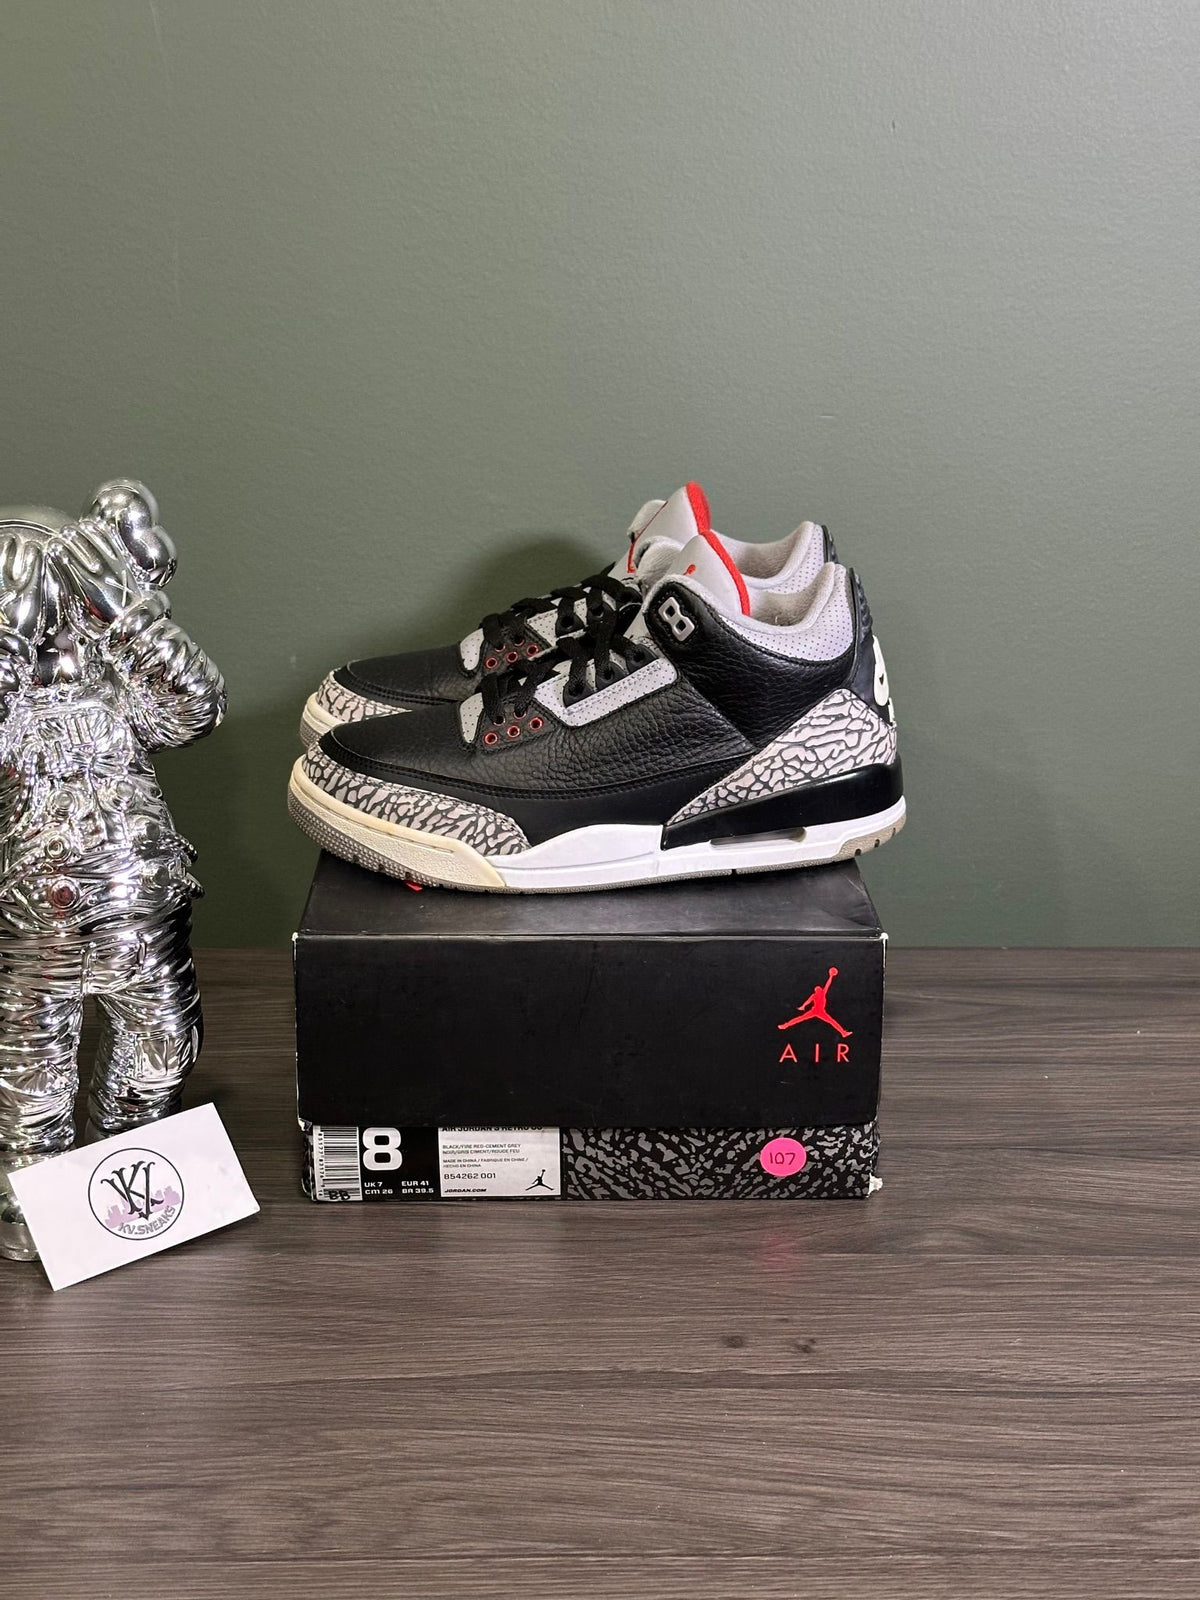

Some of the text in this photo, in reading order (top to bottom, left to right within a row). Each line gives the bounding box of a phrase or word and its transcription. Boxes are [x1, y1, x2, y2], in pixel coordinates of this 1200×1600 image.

[779, 1043, 850, 1063] AIR
[362, 1127, 403, 1171] 8
[118, 1205, 176, 1235] KV.SNEAKS
